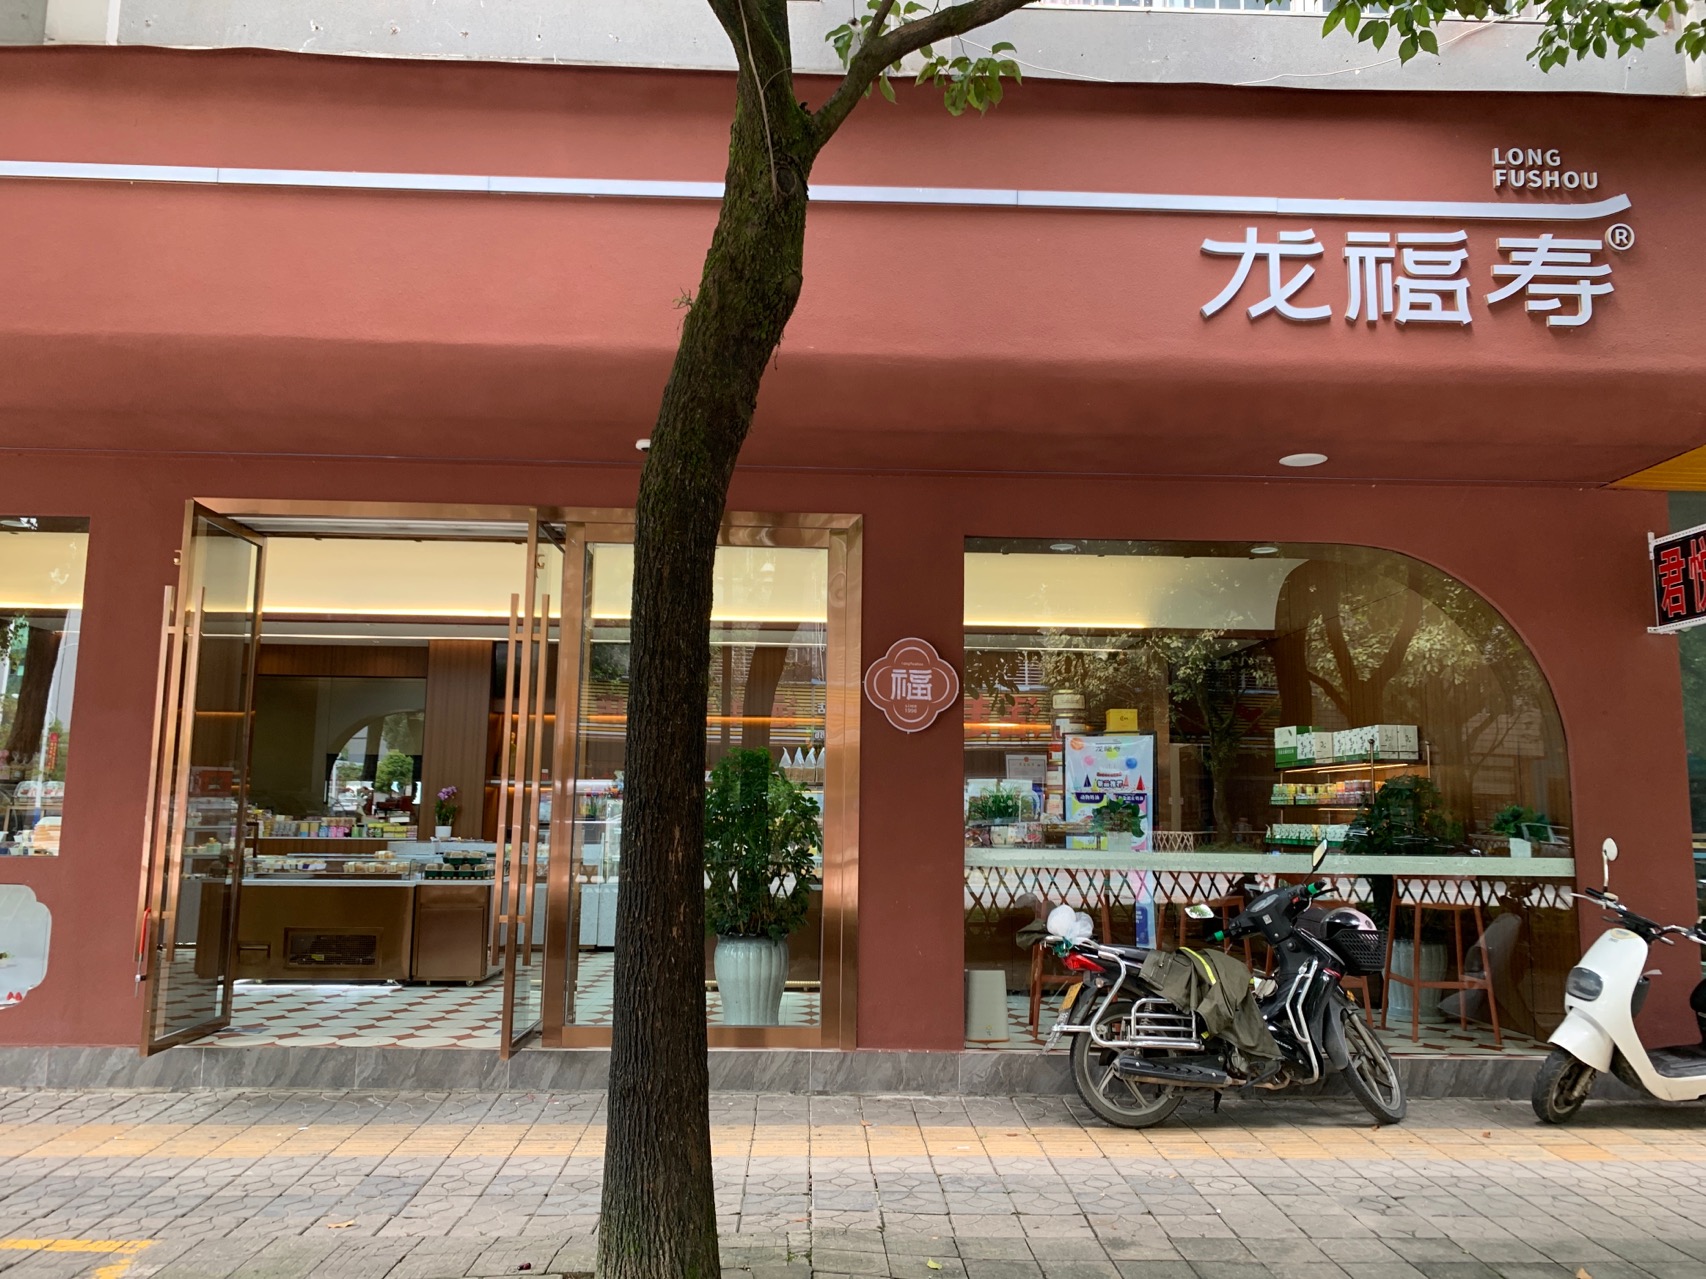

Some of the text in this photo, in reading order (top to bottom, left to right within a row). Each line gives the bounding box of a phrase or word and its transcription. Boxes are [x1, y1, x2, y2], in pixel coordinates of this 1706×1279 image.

[1492, 147, 1561, 167] LONG
[1492, 169, 1599, 190] FUSHOU
[1200, 226, 1615, 328] 龙福寿
[890, 668, 933, 701] 福
